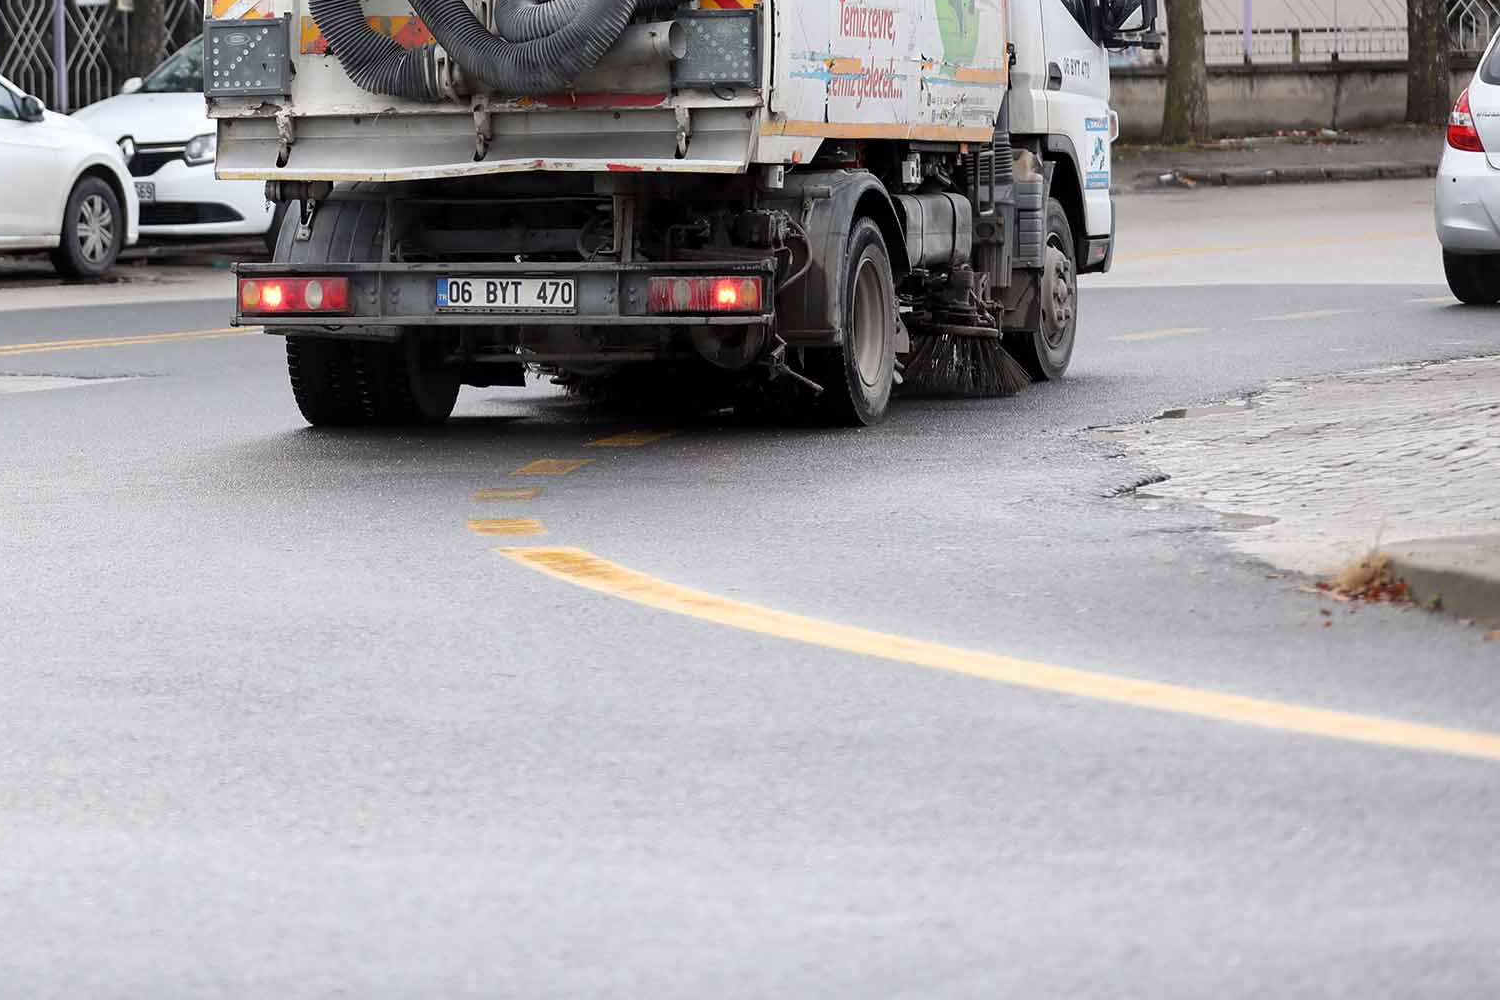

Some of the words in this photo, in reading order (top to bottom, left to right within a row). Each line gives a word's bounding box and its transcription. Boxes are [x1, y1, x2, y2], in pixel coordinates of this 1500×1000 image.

[867, 7, 896, 50] çevre,
[449, 281, 472, 303] 06
[486, 281, 522, 304] BYT
[536, 281, 572, 304] 470
